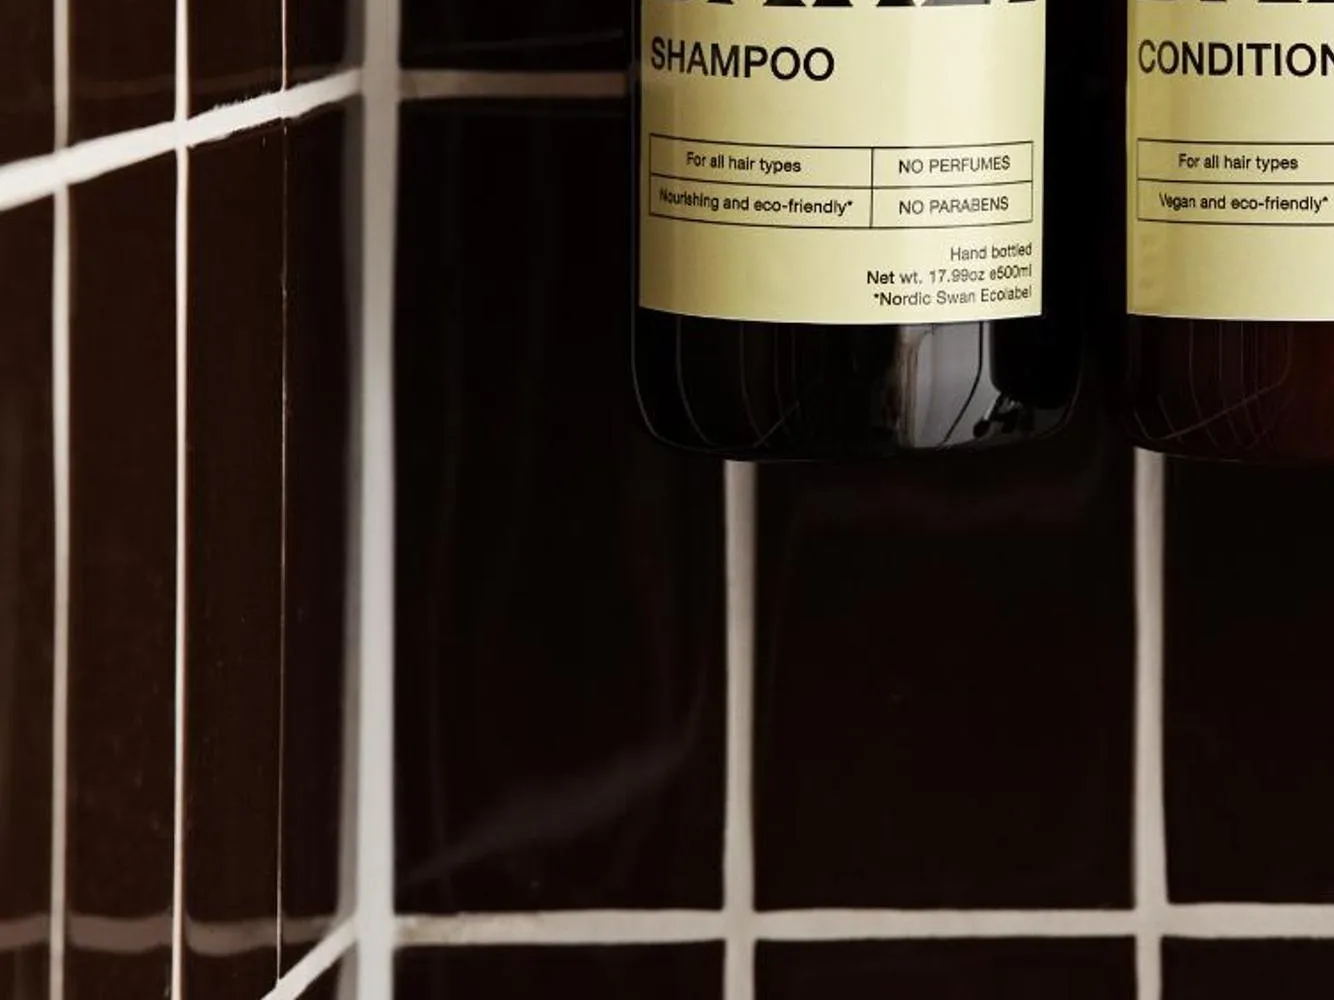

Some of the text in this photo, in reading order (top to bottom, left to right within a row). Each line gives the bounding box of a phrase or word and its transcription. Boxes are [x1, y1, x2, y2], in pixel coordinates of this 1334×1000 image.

[651, 36, 835, 81] SHAMPOO
[686, 151, 801, 174] For all hair types
[899, 156, 1010, 173] NO PERFUMES
[1179, 154, 1299, 173] For all hair types
[659, 189, 720, 211] Nourishing
[723, 195, 749, 211] and
[899, 197, 1009, 214] NO PARABENS
[1160, 192, 1196, 211] Vegan
[1200, 194, 1226, 210] and
[950, 242, 1032, 261] Hand bottled
[867, 269, 895, 285] Net
[899, 271, 923, 284] wt.
[930, 268, 985, 283] 17.99oz
[937, 289, 976, 306] Swan
[981, 286, 1032, 303] Ecolabel
